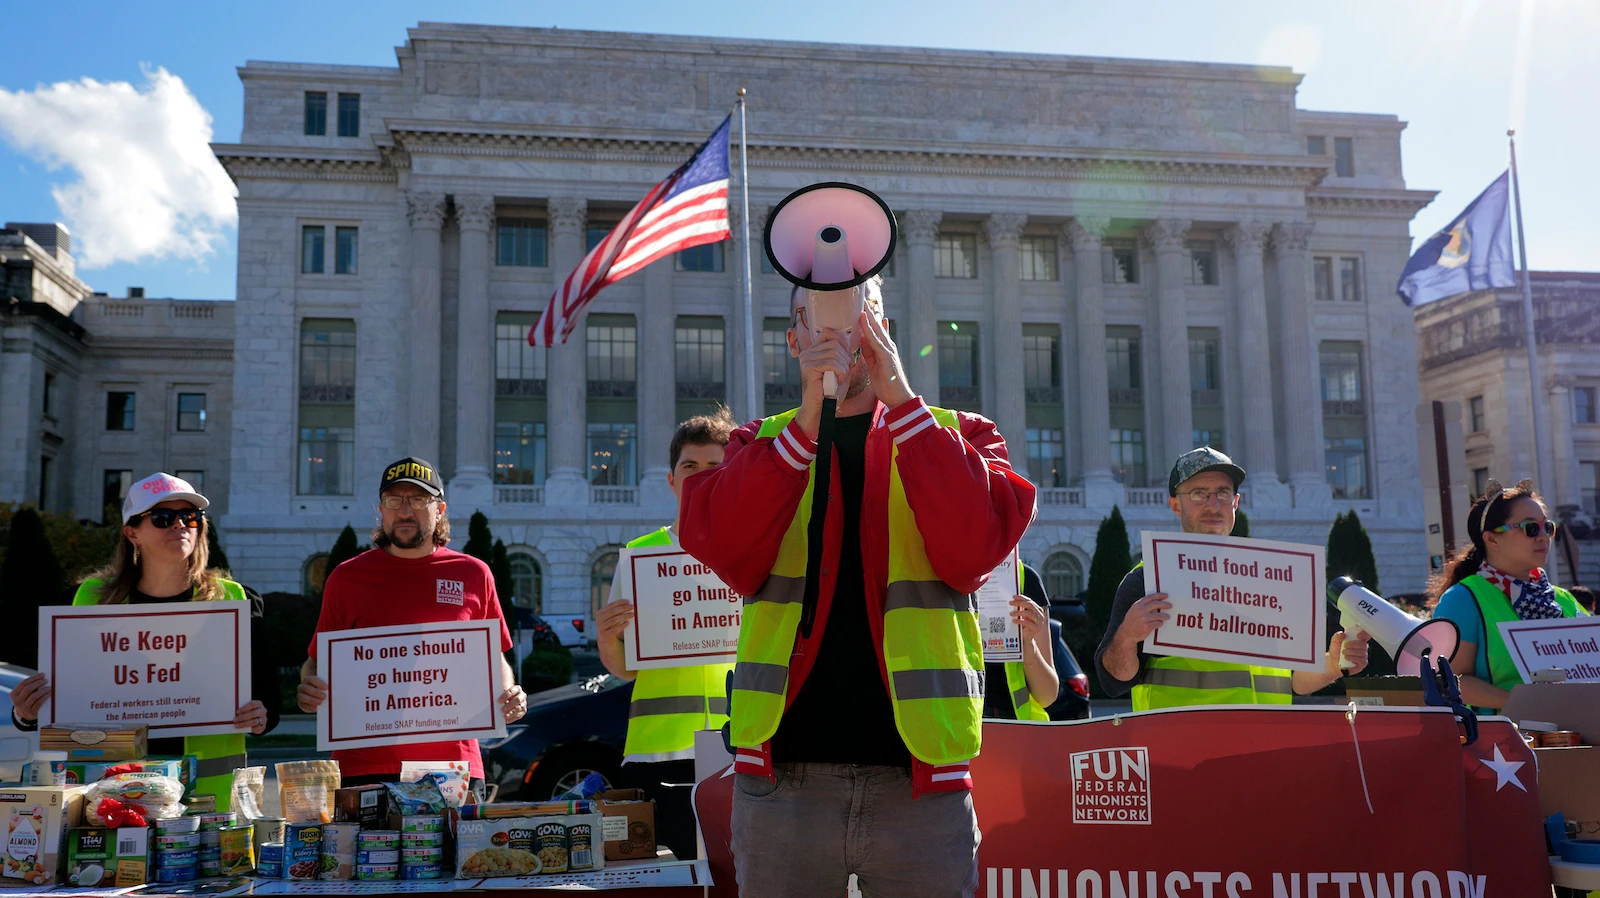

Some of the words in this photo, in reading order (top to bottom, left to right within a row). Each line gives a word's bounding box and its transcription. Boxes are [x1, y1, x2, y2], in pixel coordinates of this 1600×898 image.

[387, 462, 433, 482] SPIRIT
[142, 478, 165, 490] Out
[657, 562, 677, 578] No
[683, 563, 711, 576] one
[1178, 553, 1218, 573] Fund
[1223, 558, 1258, 578] food
[1264, 565, 1293, 582] and
[438, 579, 463, 591] FUN
[673, 590, 691, 606] go
[697, 585, 744, 603] hung
[1191, 581, 1283, 612] healthcare,
[1358, 599, 1379, 616] PYLE
[671, 614, 686, 630] in
[692, 610, 742, 629] Ameri
[1176, 612, 1203, 629] not
[1209, 612, 1294, 641] ballrooms.
[100, 632, 130, 652] We
[138, 631, 187, 653] Keep
[354, 645, 374, 661] No
[379, 645, 407, 659] one
[413, 638, 465, 656] should
[673, 642, 700, 651] Release
[702, 639, 720, 648] SNAP
[723, 639, 738, 647] fund
[1532, 639, 1567, 656] Fund
[1568, 637, 1599, 654] food
[114, 665, 139, 685] Us
[147, 662, 180, 683] Fed
[367, 672, 386, 689] go
[392, 668, 448, 685] hungry
[1553, 663, 1600, 680] ealth
[90, 700, 120, 709] Federal
[123, 699, 154, 708] workers
[156, 698, 170, 706] still
[173, 697, 200, 705] serving
[365, 696, 380, 712] in
[386, 691, 457, 710] America.
[106, 712, 119, 721] the
[122, 711, 157, 720] American
[160, 709, 186, 720] people
[365, 721, 392, 731] Release
[394, 720, 414, 729] SNAP
[415, 718, 441, 728] funding
[443, 716, 458, 725] now!
[1073, 750, 1146, 781] FUN
[1076, 780, 1146, 792] FEDERAL
[51, 794, 57, 803] 6
[1076, 794, 1147, 806] UNIONISTS
[1076, 808, 1147, 820] NETWORK
[538, 825, 565, 836] GOYA
[9, 837, 38, 846] ALMOND
[81, 836, 103, 845] THAI
